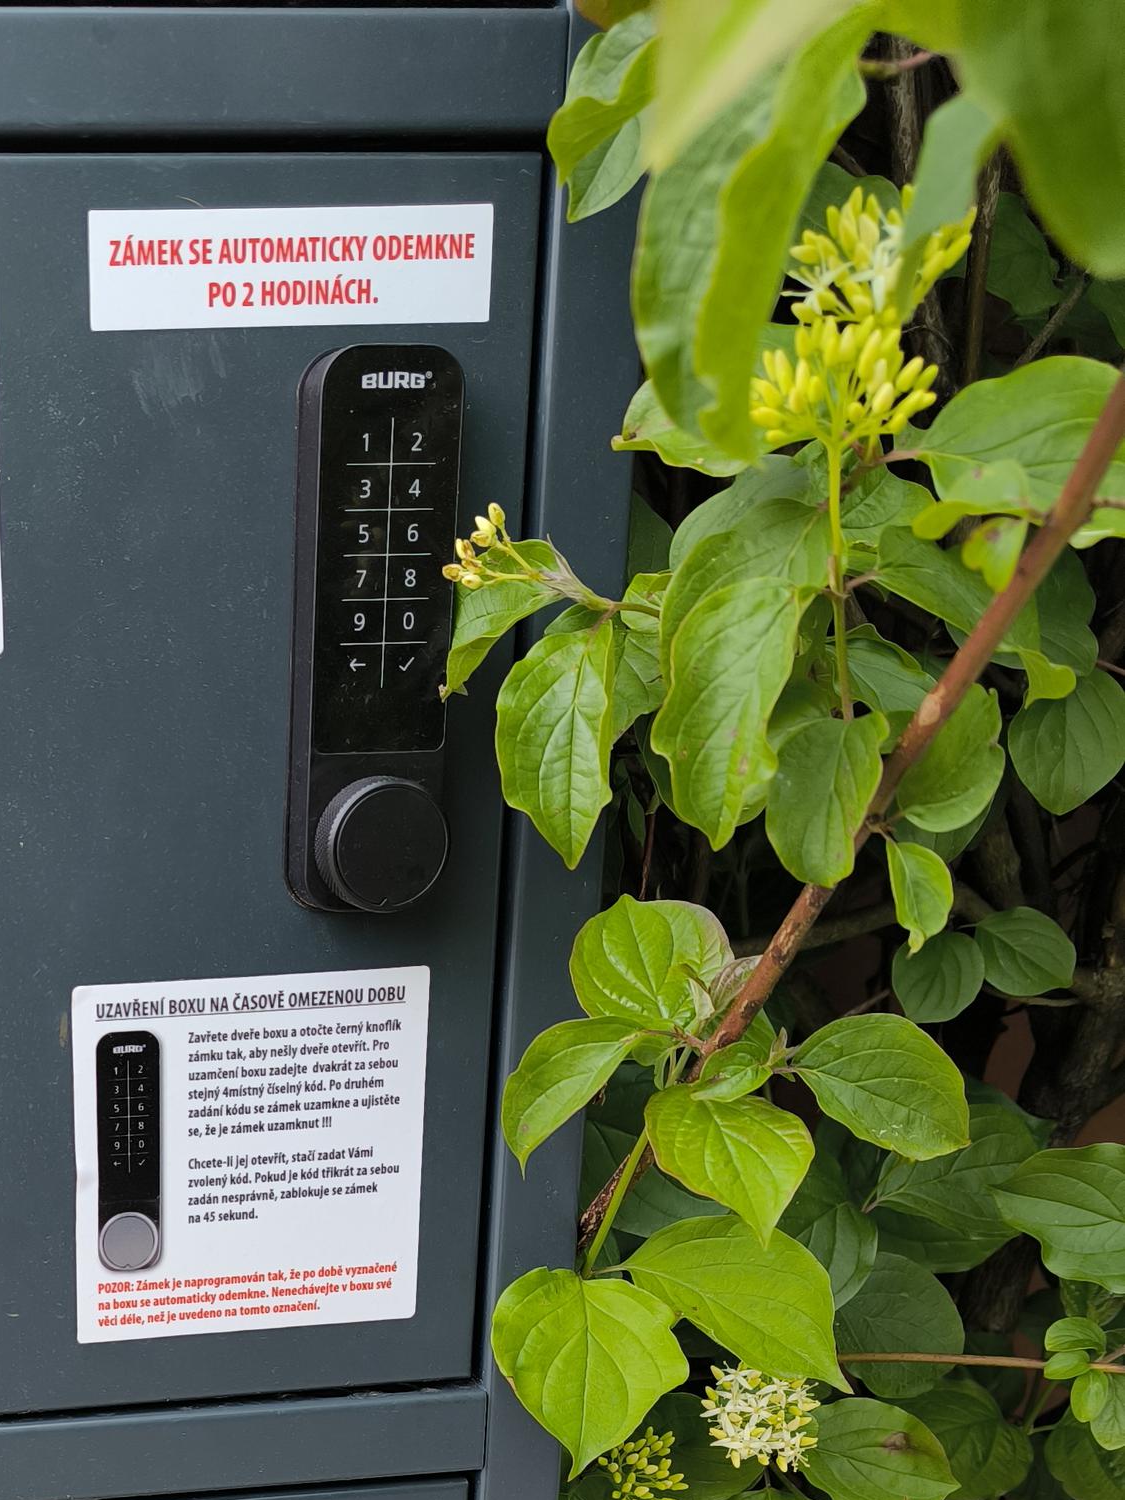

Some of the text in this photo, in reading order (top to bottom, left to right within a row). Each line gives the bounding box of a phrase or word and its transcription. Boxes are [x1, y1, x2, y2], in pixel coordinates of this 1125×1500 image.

[109, 233, 475, 266] ZÁMEK SE AUTOMATICKY ODEMKNE
[208, 273, 378, 307] PO 2 HODINÁCH.
[363, 432, 422, 451] 1 2
[360, 479, 420, 498] 3 4
[359, 524, 418, 543] 5 6
[357, 569, 415, 587] 7 8
[355, 613, 365, 631] 9
[96, 985, 406, 1019] UZAVŘENÍ BOXU NA ČASOVĚ OMEZENOU DOBU
[188, 1018, 401, 1044] Zavřete dveře boxu a otočte černý knoflík
[188, 1039, 389, 1062] zámku tak, aby nešly dveře otevřít. Pro
[188, 1207, 258, 1224] na 45 sekund.
[98, 1260, 397, 1294] POZOR: Zámek je naprogramován tak, že po době vyznačené
